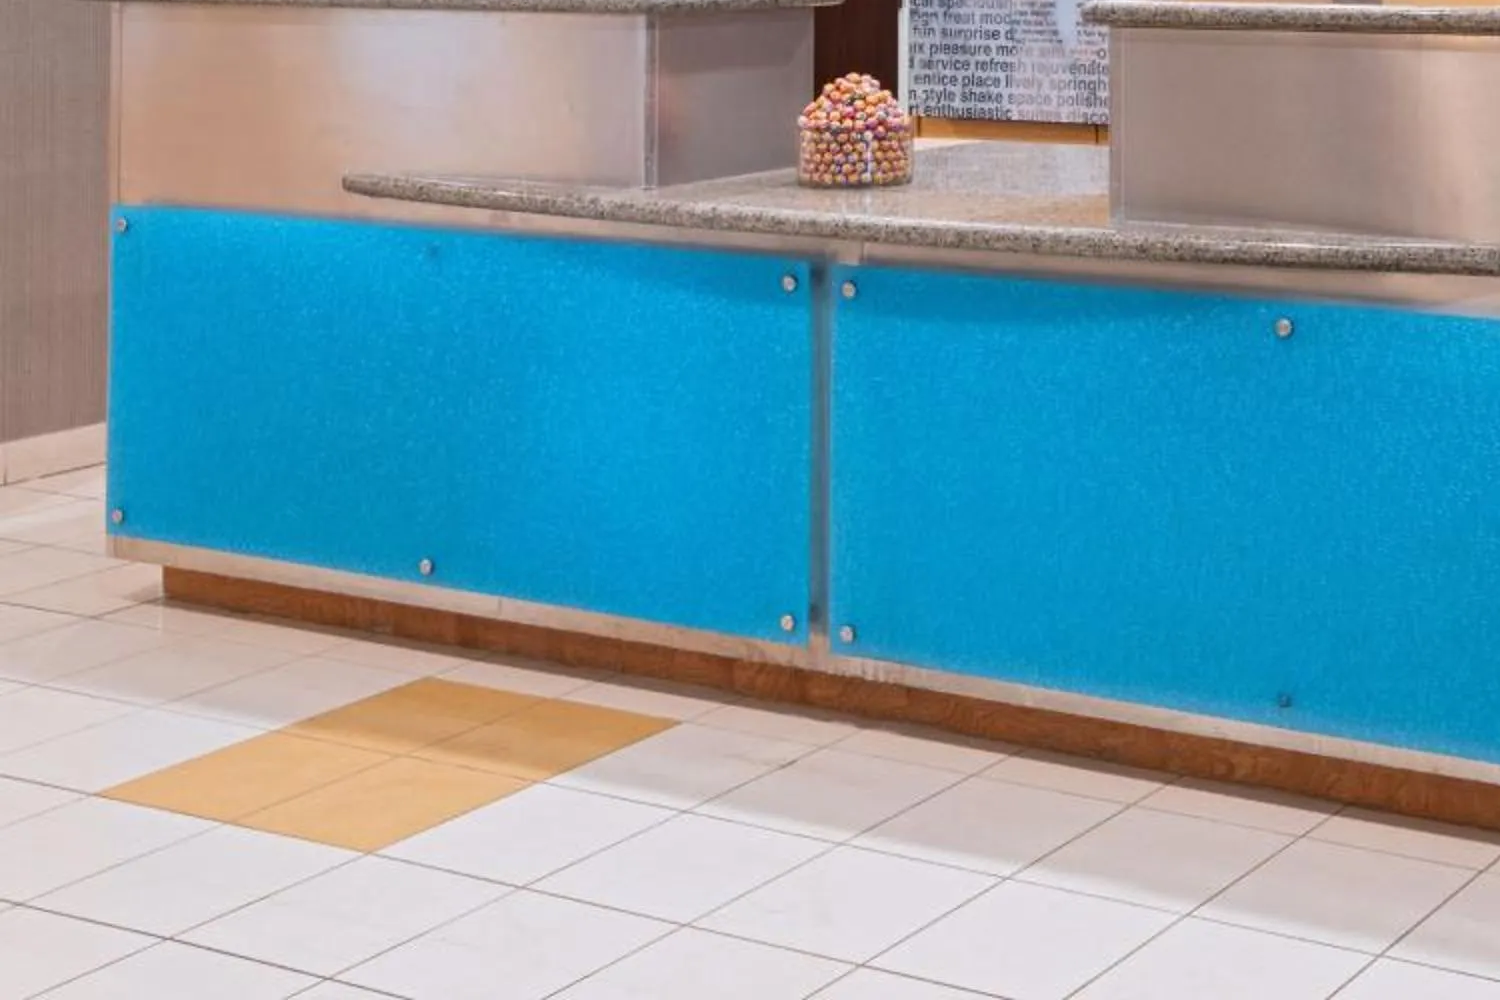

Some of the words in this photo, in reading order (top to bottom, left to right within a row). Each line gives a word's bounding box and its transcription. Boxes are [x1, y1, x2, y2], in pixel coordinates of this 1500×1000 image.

[940, 25, 1002, 42] surprise
[929, 42, 992, 58] pleasure
[975, 58, 1027, 73] refresh
[914, 73, 958, 88] entice
[961, 74, 1001, 90] place
[960, 89, 1004, 105] shake
[923, 104, 1012, 120] enthusiastic
